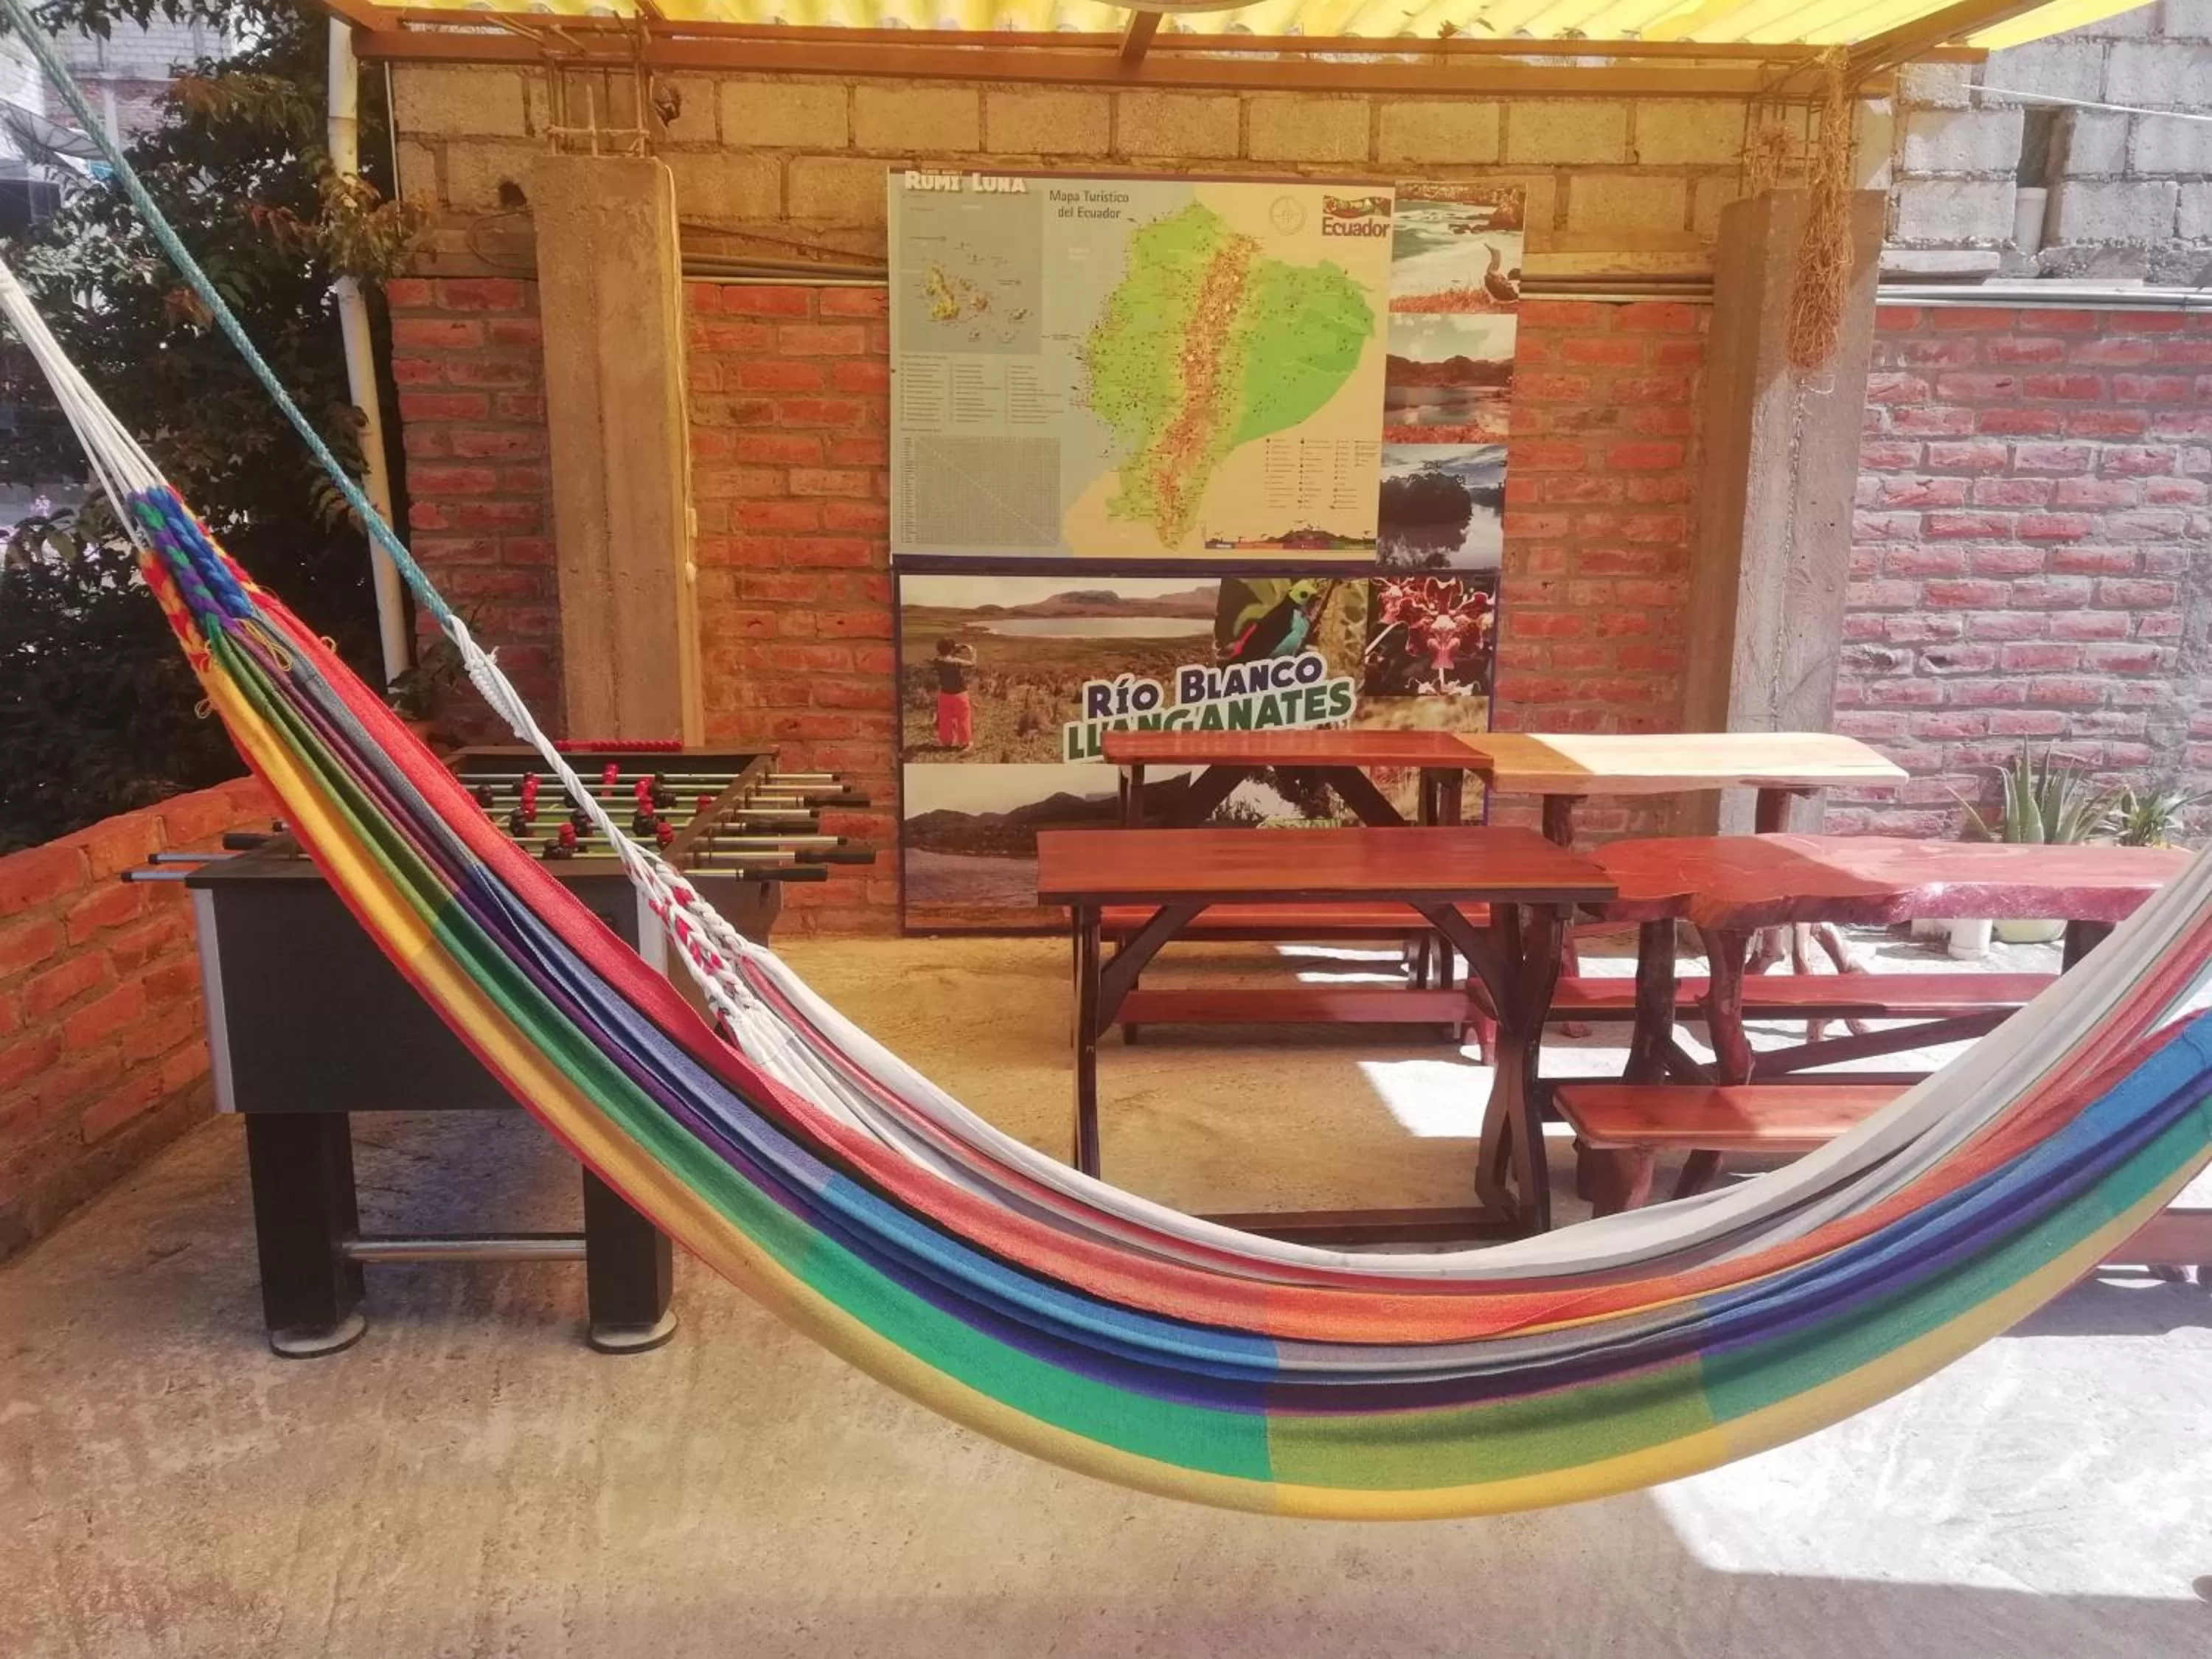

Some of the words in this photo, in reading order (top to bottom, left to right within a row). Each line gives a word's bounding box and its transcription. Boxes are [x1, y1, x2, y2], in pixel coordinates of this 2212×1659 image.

[905, 170, 960, 190] RUMI
[972, 173, 1026, 192] LUNA
[1049, 189, 1080, 204] Mapa
[1058, 206, 1074, 218] del
[1077, 206, 1121, 219] Ecuador
[1322, 217, 1390, 237] Ecuador
[1088, 678, 1159, 719] RÍO
[1181, 656, 1323, 704] BLANCO
